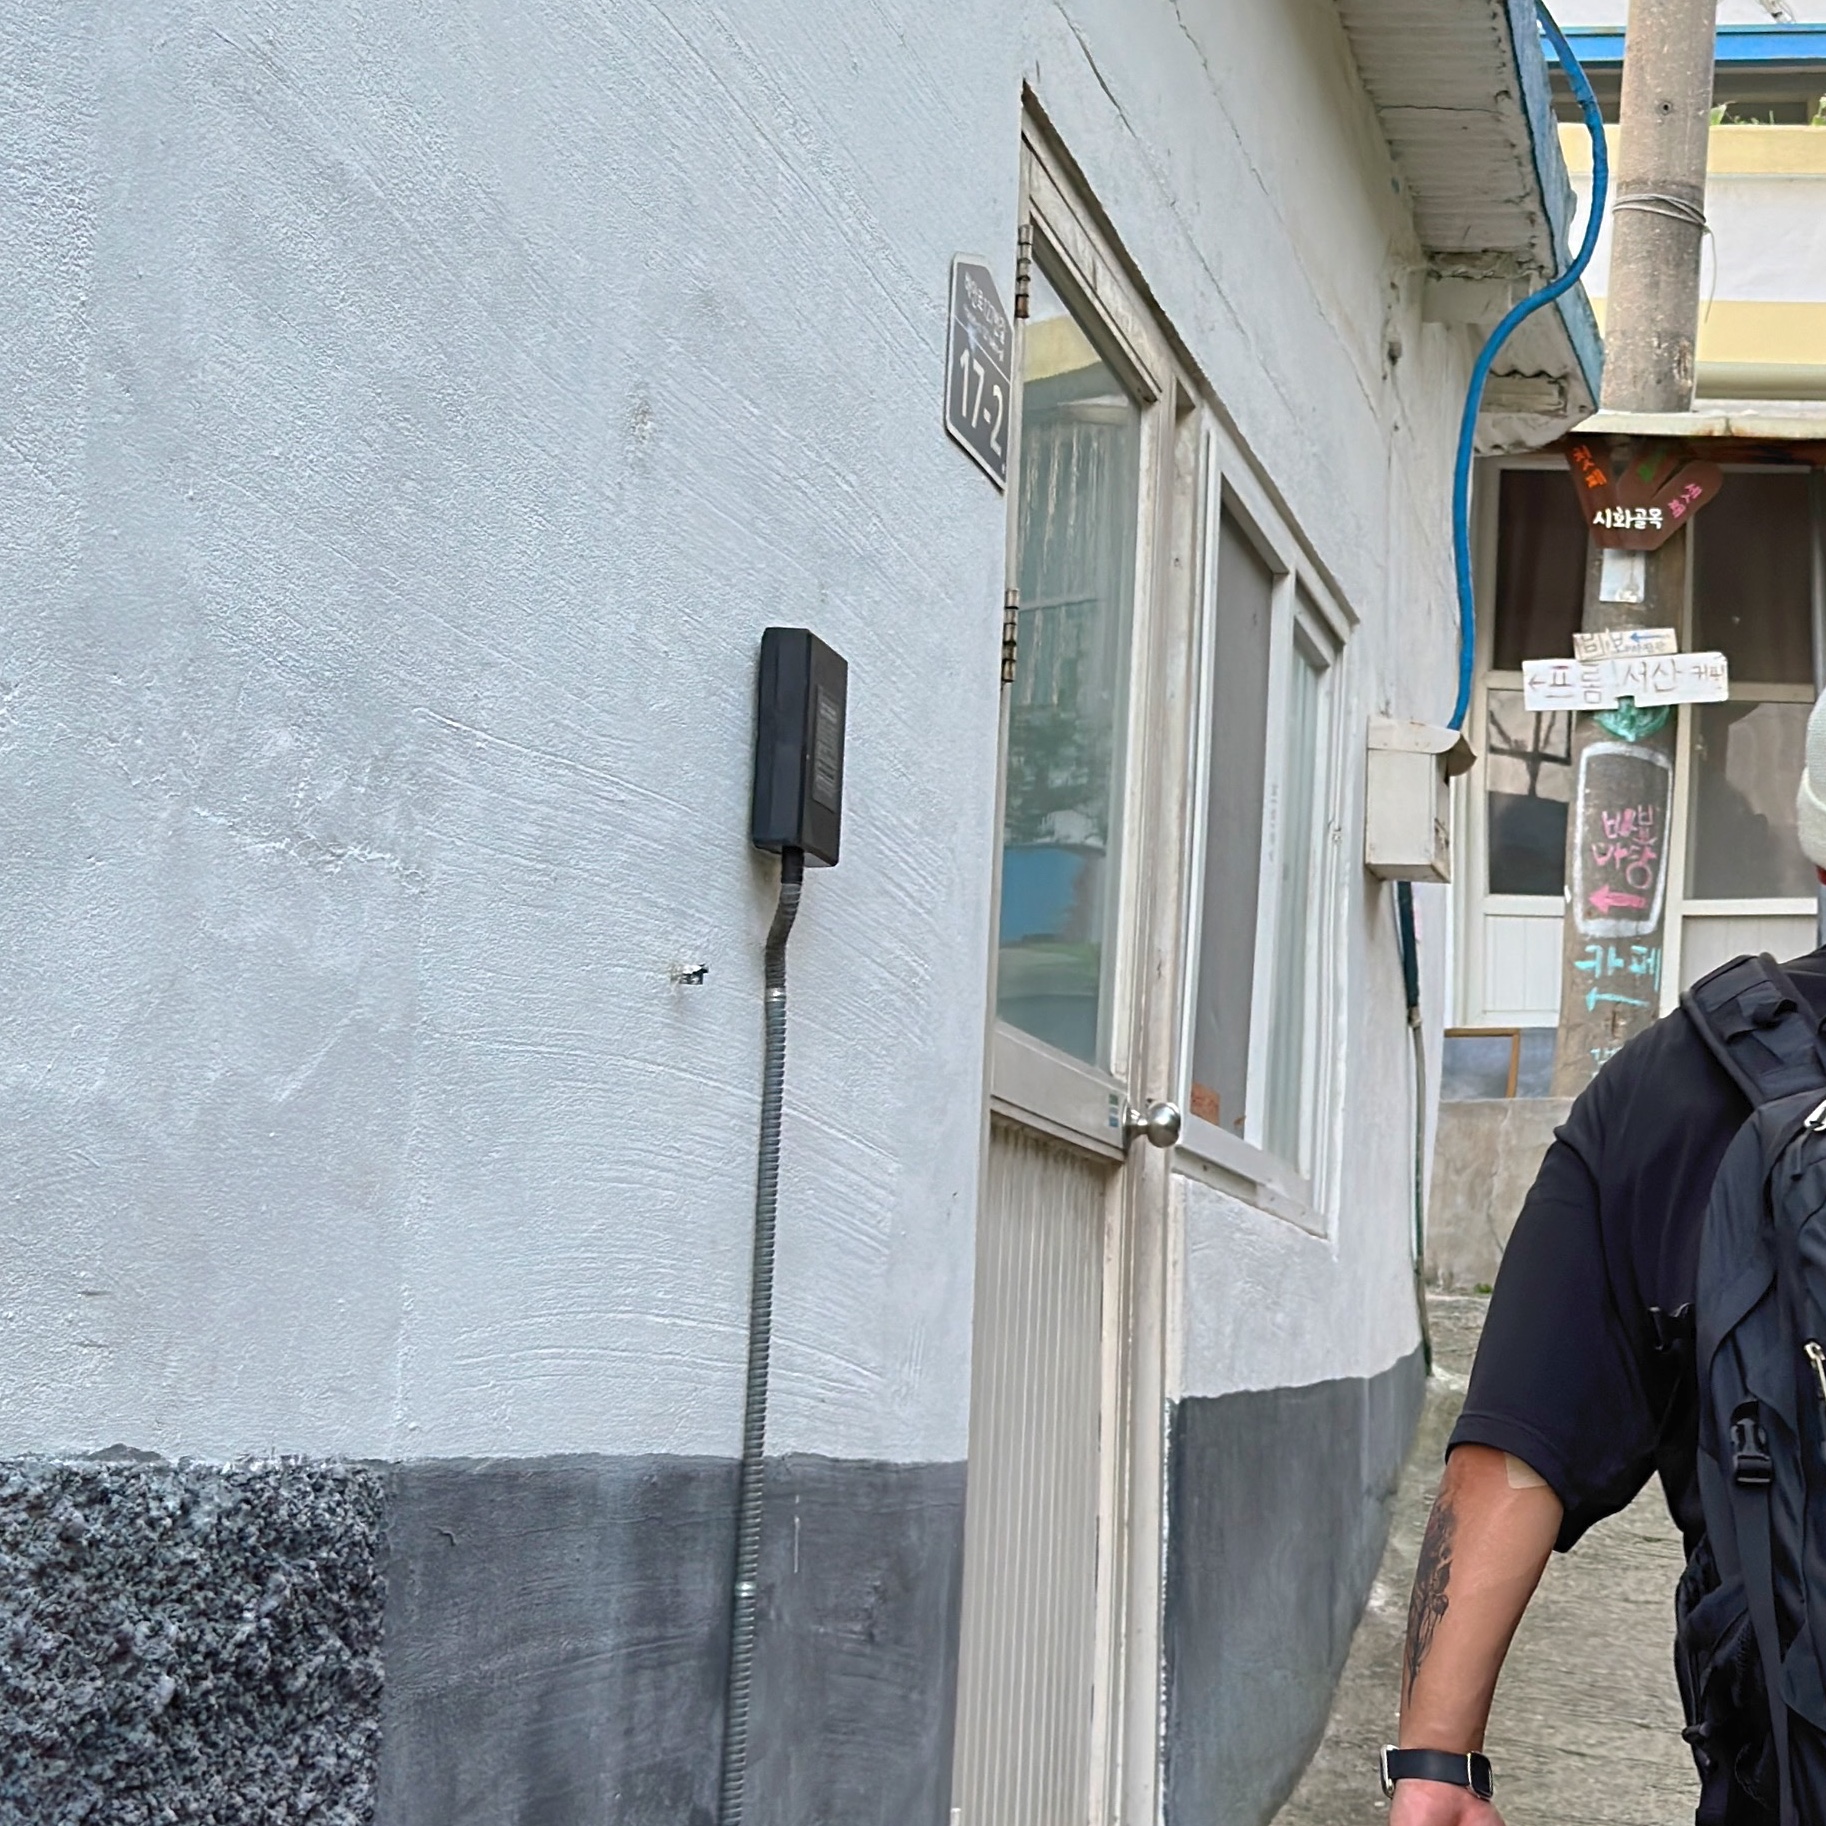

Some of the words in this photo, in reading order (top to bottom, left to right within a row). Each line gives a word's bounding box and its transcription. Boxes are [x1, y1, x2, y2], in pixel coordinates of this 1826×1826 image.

[959, 347, 1003, 458] 17-2
[1592, 505, 1664, 530] 시화골목
[1622, 658, 1683, 694] 서산
[1591, 842, 1658, 890] 마당
[1573, 943, 1662, 992] 카페
